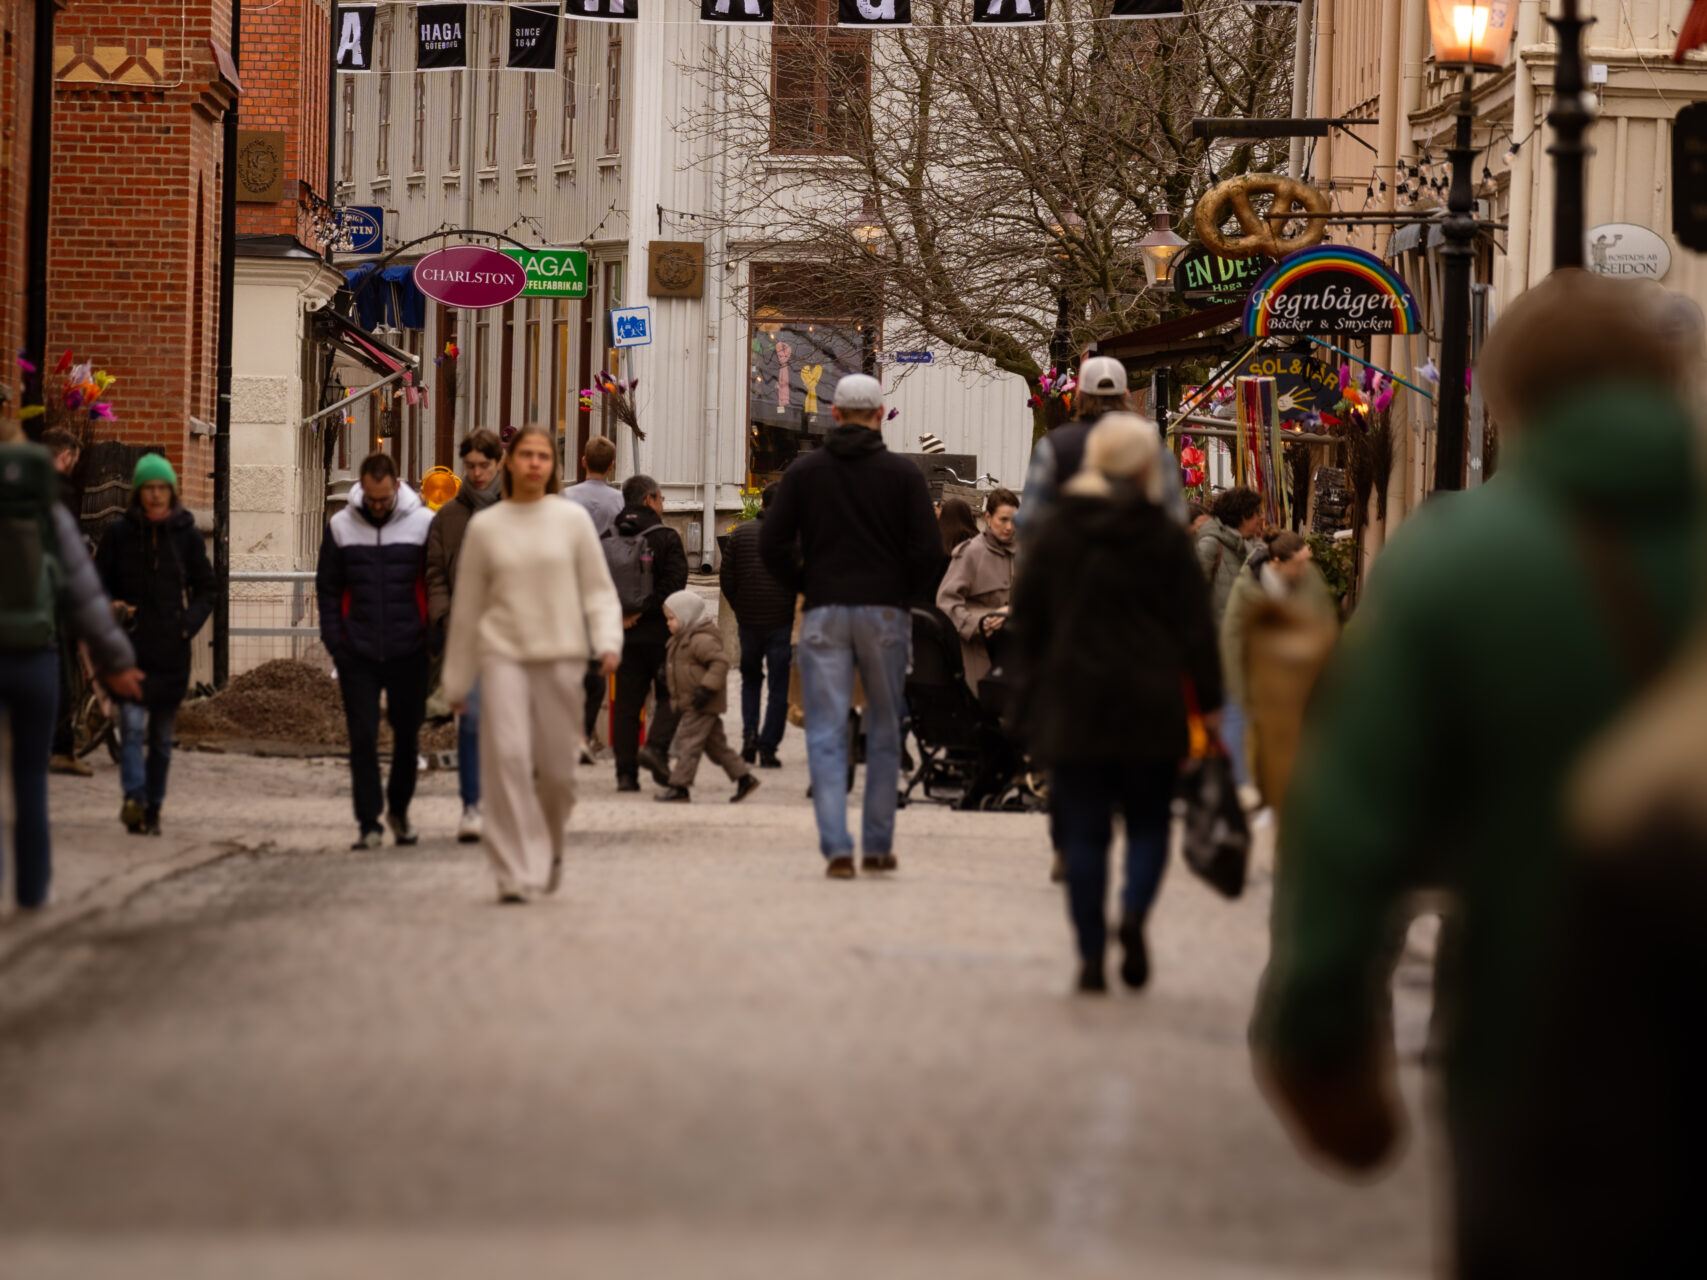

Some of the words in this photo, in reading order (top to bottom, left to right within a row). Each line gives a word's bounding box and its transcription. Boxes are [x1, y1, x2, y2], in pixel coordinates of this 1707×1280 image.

[337, 11, 365, 66] A
[421, 23, 462, 41] HAGA
[515, 27, 541, 37] SINCE
[519, 256, 577, 277] AGA
[1185, 255, 1213, 288] EN
[1589, 263, 1657, 275] OSEIDON
[422, 268, 515, 286] CHARLSTON
[526, 280, 571, 291] FELFABRIK
[572, 281, 583, 291] AB
[1212, 281, 1242, 291] Haga
[1252, 285, 1410, 318] Regnbågens
[1267, 316, 1313, 331] Böcker
[1320, 320, 1330, 329] &
[1335, 316, 1392, 332] Smycken
[1250, 359, 1287, 377] SOL
[1289, 358, 1302, 375] &
